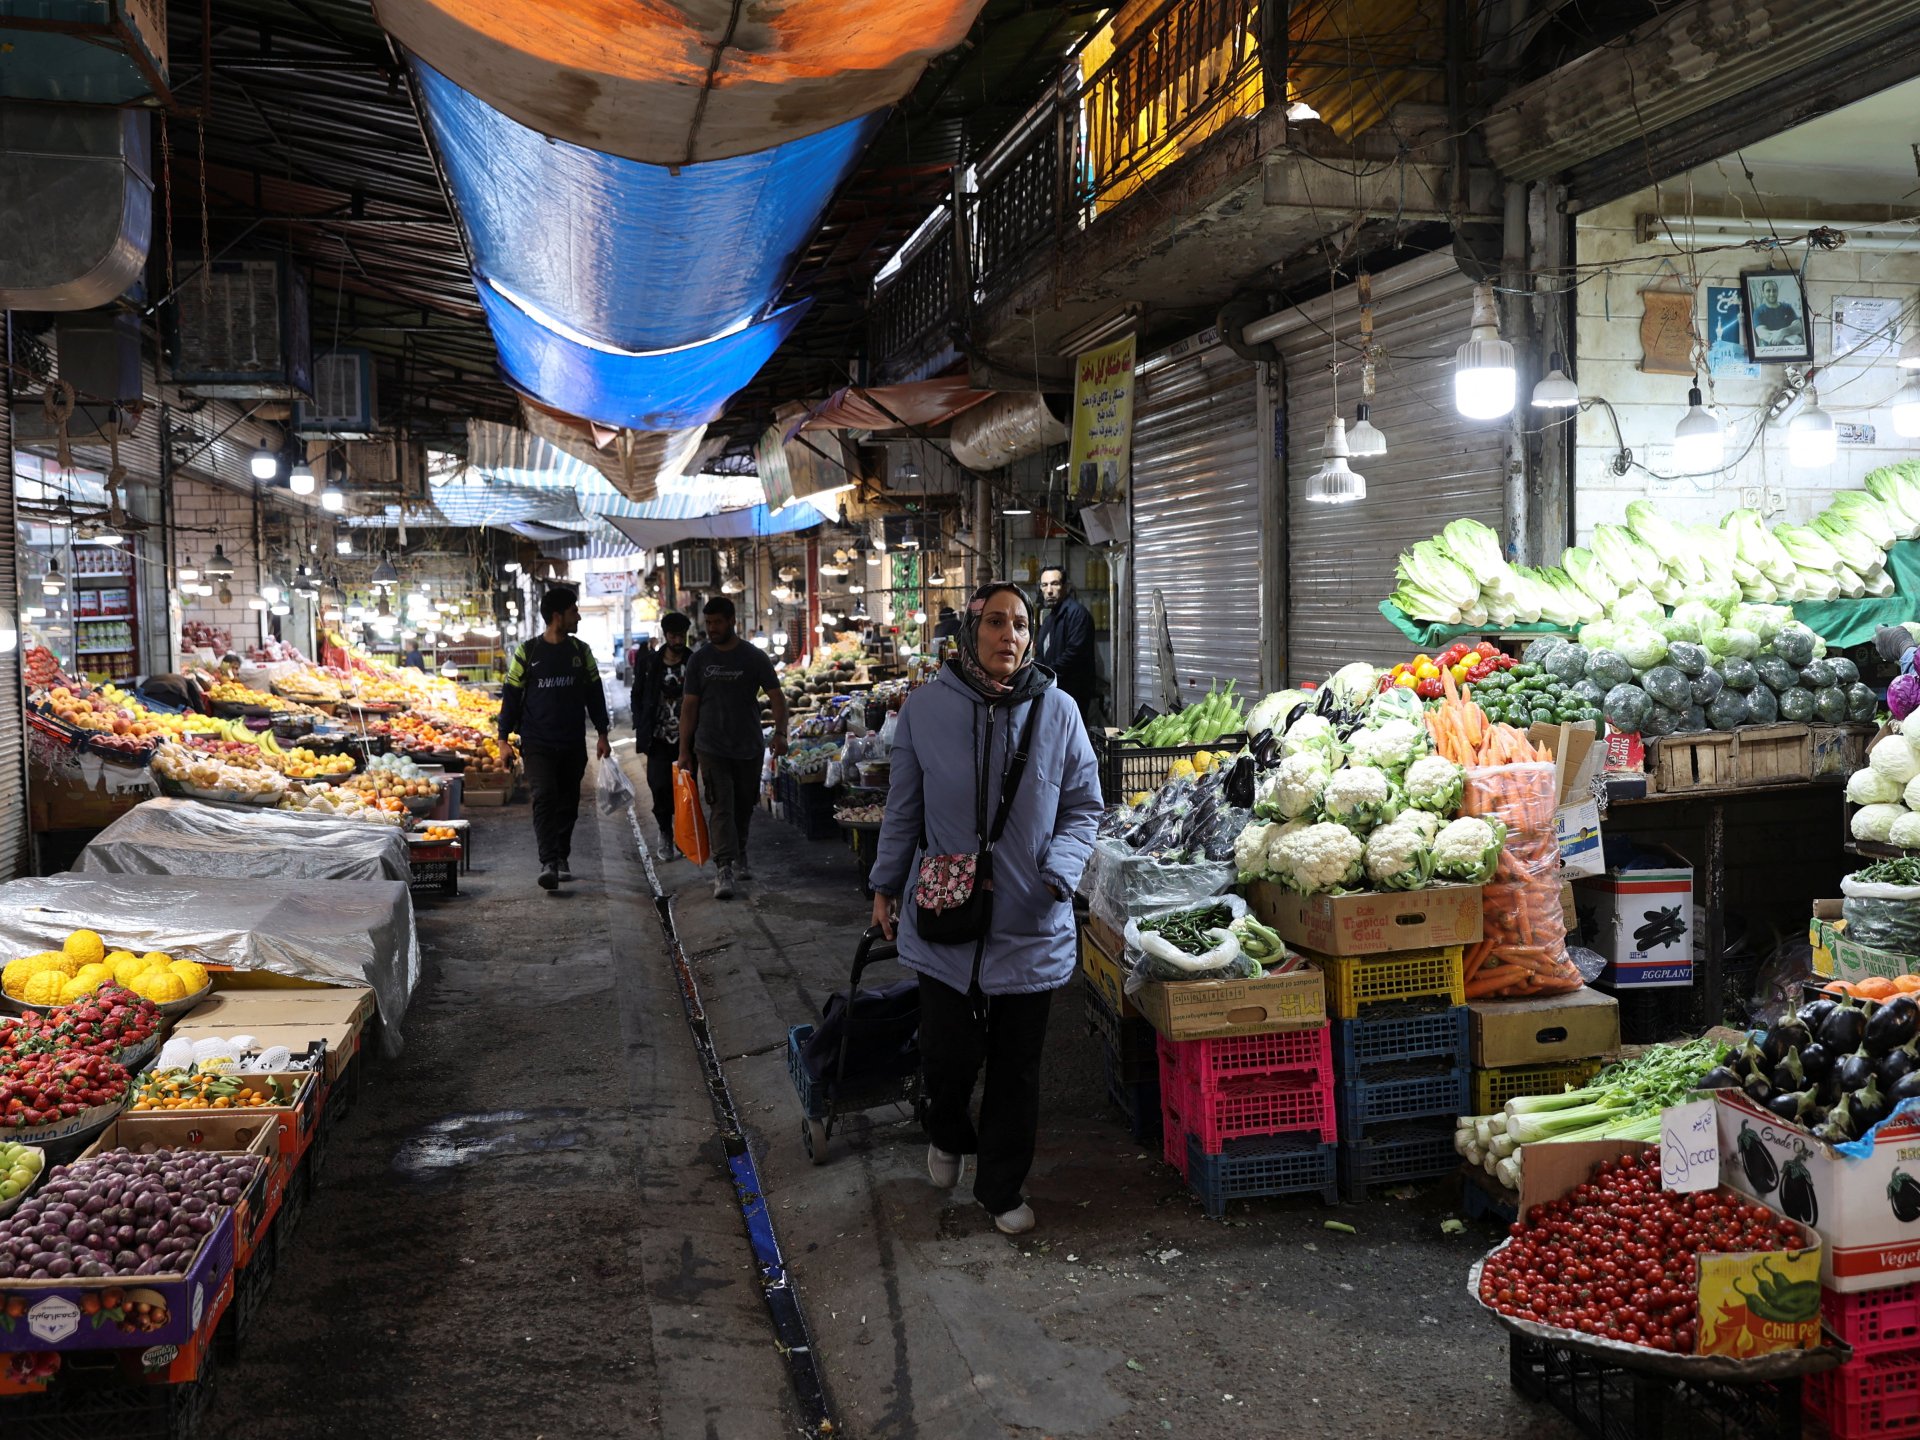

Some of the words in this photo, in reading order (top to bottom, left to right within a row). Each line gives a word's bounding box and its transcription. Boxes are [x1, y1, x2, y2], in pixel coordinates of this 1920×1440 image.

[1611, 737, 1621, 754] LUX
[1618, 738, 1630, 766] SUPER
[1342, 916, 1389, 930] Tropical
[1352, 928, 1381, 941] Gold
[1641, 969, 1693, 980] EGGPLANT
[1864, 960, 1900, 978] PINEAPPLE
[1284, 980, 1292, 989] of
[1295, 978, 1319, 987] product
[1761, 1125, 1791, 1149] Grade
[1793, 1137, 1814, 1161] One
[1762, 1322, 1795, 1339] Chili
